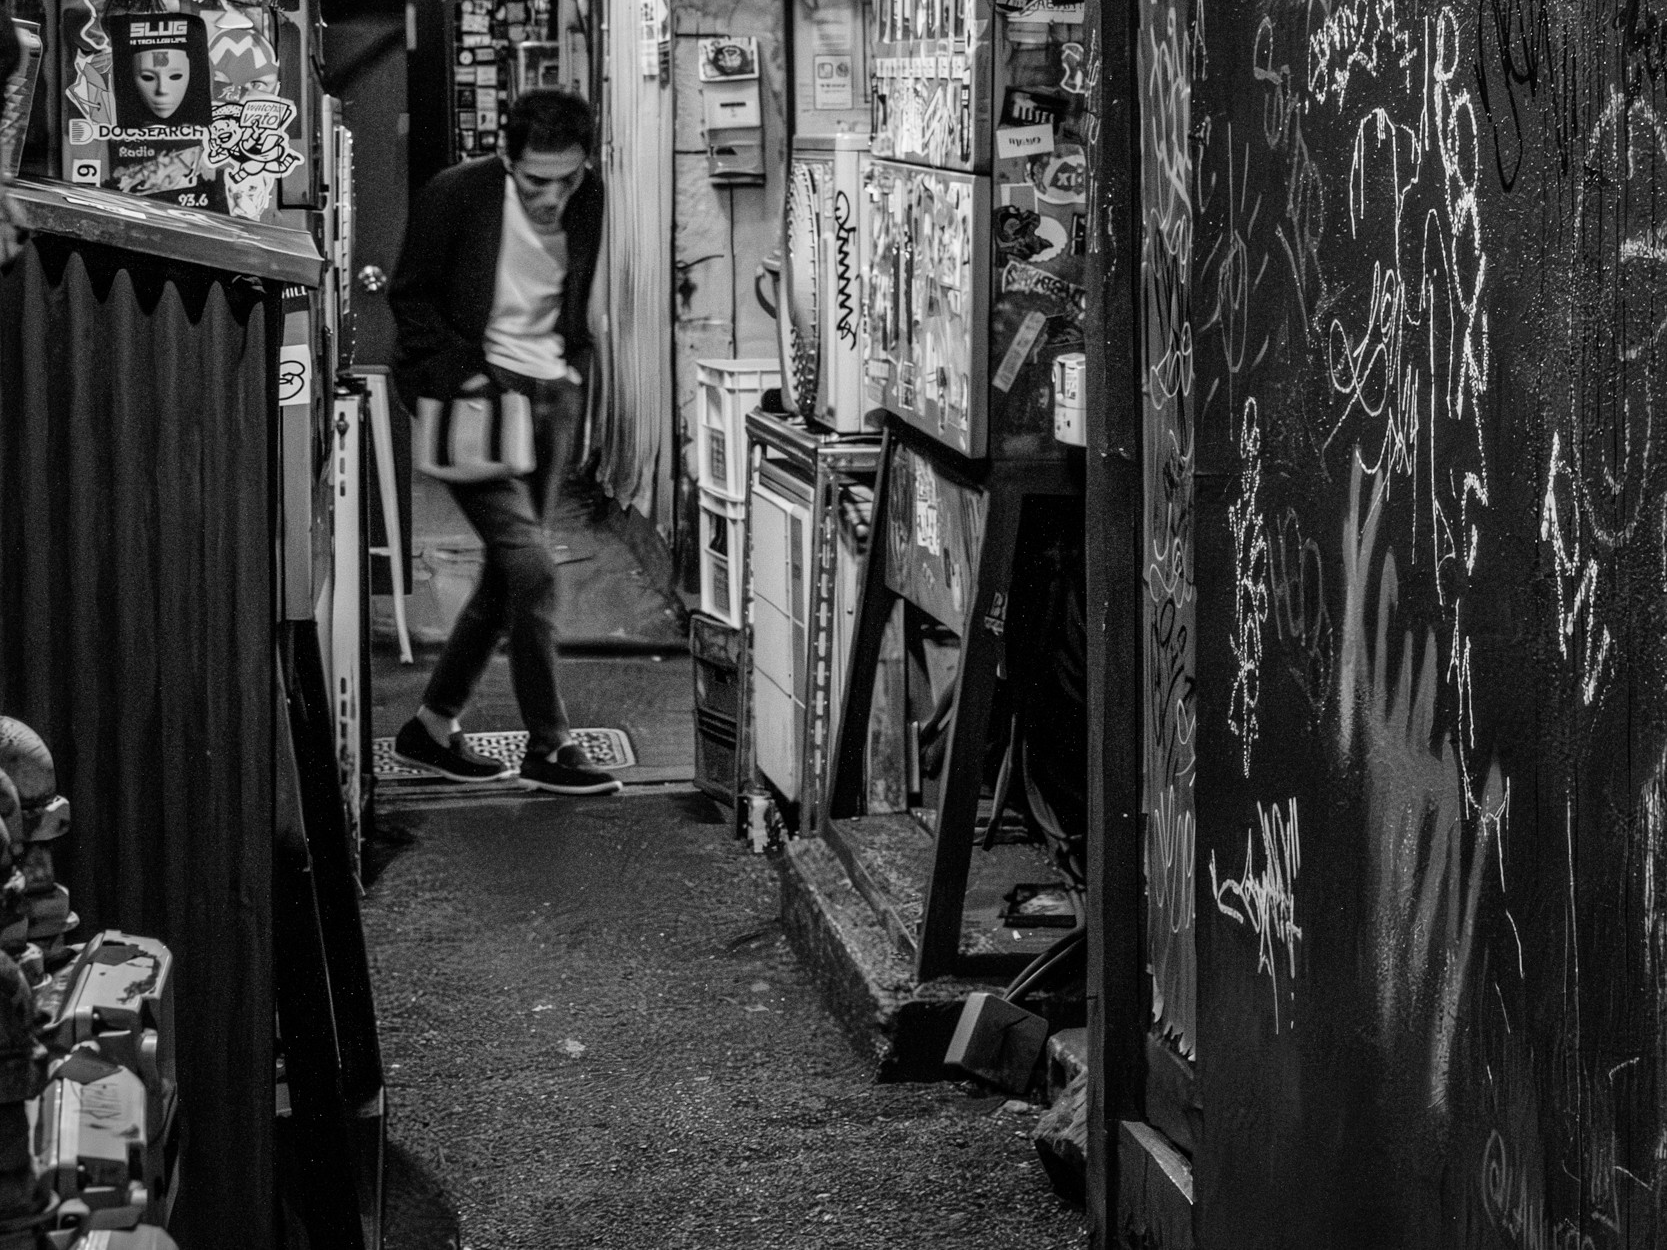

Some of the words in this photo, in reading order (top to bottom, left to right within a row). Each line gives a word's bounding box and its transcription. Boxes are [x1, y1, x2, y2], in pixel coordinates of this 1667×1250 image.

[130, 21, 188, 37] SLUG
[119, 146, 155, 158] Radio
[178, 193, 209, 207] 93.6
